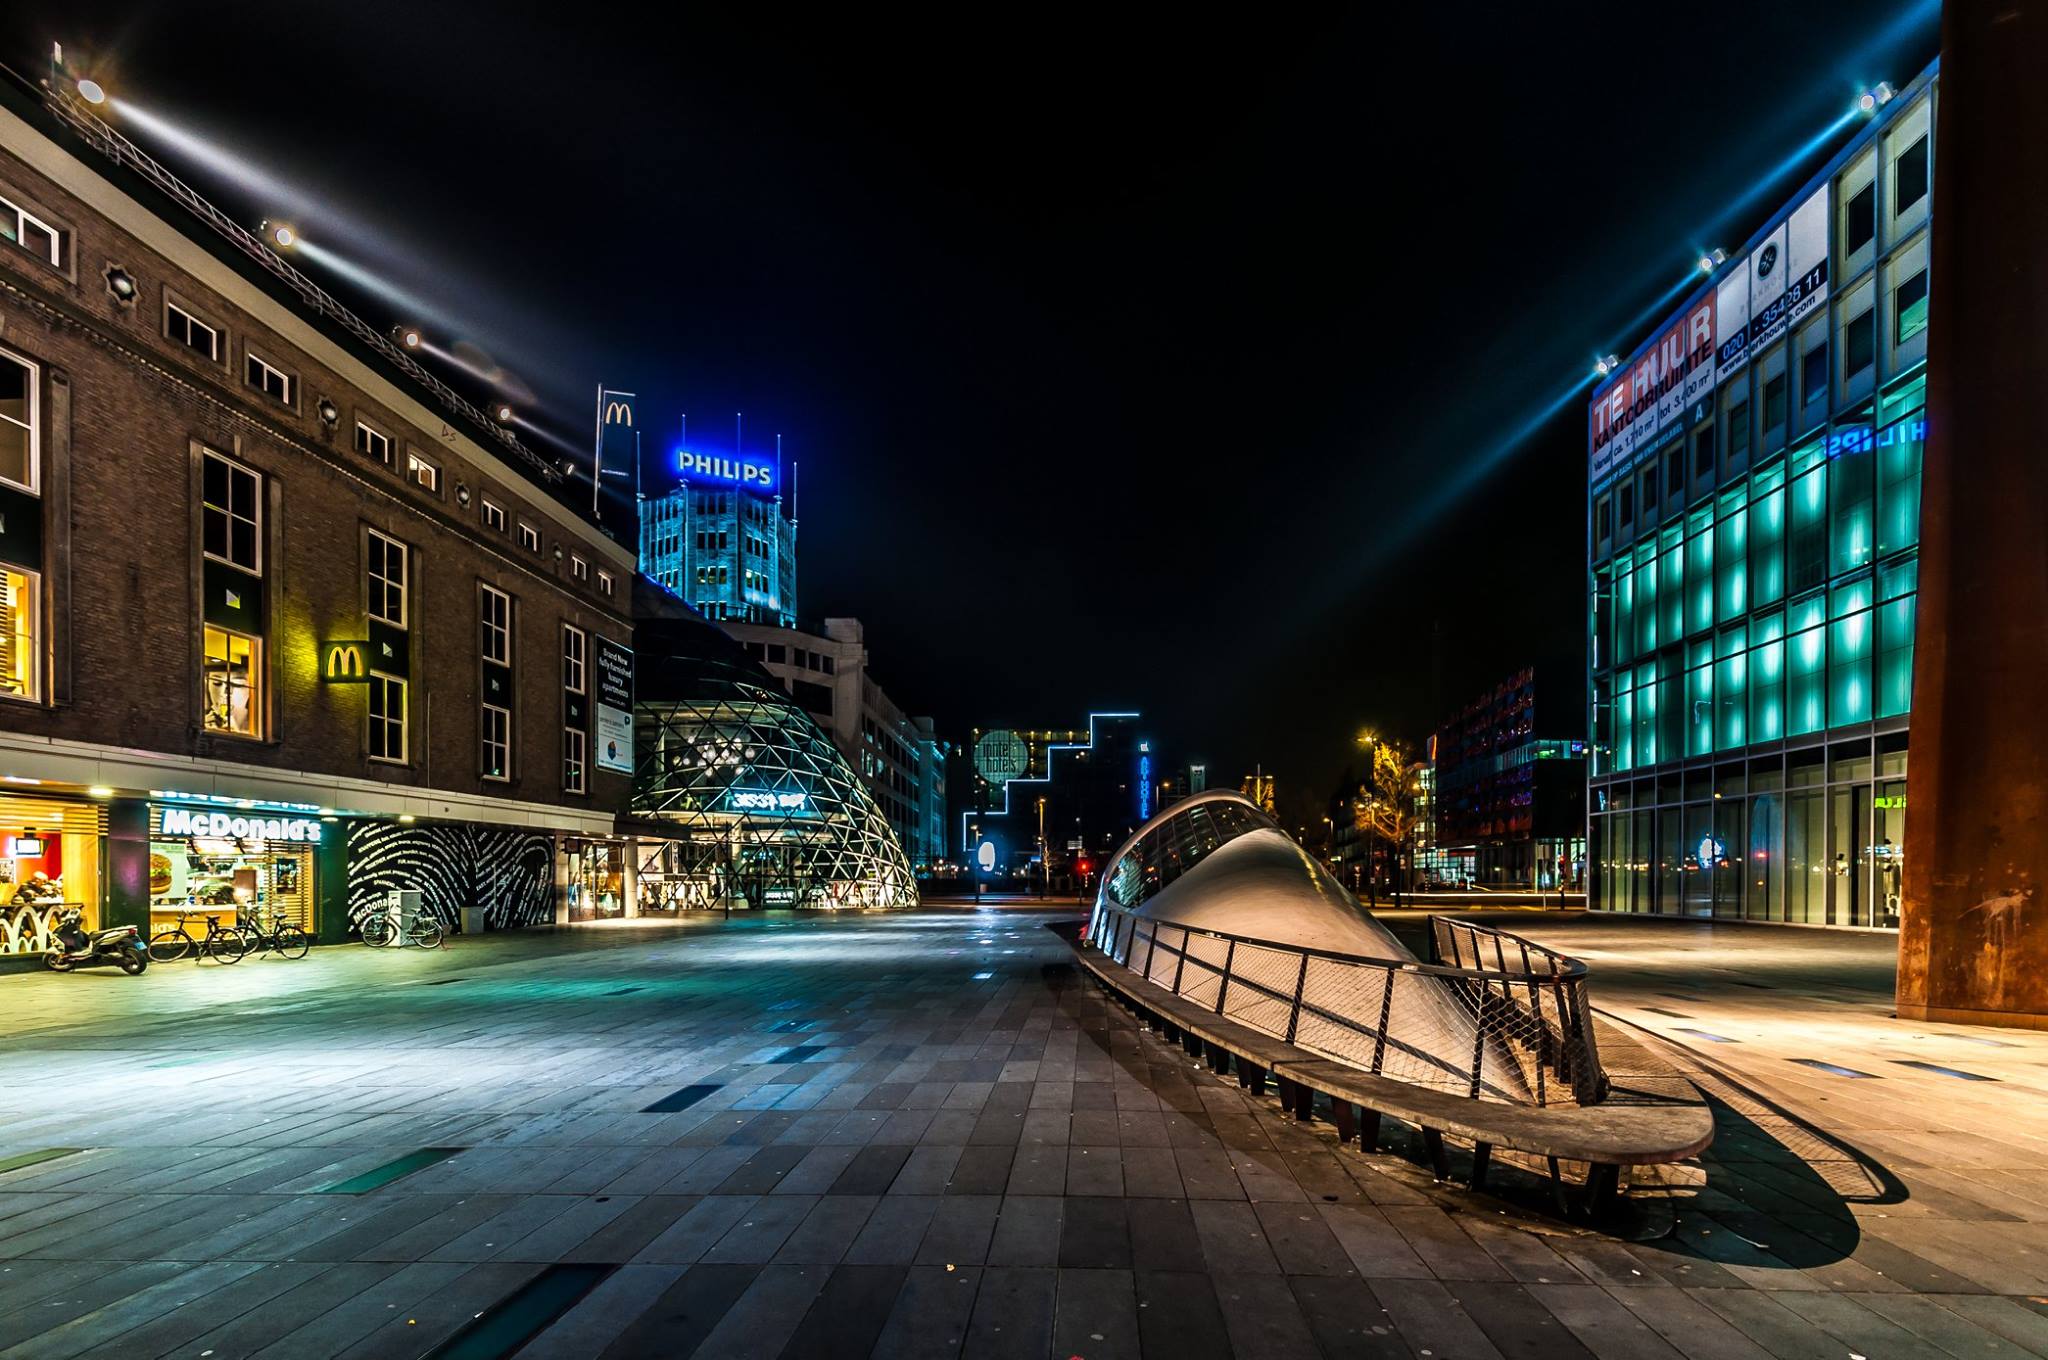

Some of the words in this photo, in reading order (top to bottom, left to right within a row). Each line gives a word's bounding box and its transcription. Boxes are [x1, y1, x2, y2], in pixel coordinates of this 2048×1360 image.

[1723, 333, 1745, 360] 020
[1806, 268, 1820, 290] 11
[1594, 382, 1624, 433] TE
[1632, 305, 1711, 400] HUUR
[1659, 403, 1671, 420] tot
[1695, 404, 1704, 422] A
[678, 451, 772, 485] PHILIPS
[603, 648, 617, 661] Brand
[618, 654, 628, 666] New
[986, 757, 1017, 773] hotels
[162, 809, 321, 841] McDonald's
[353, 898, 389, 924] McDona
